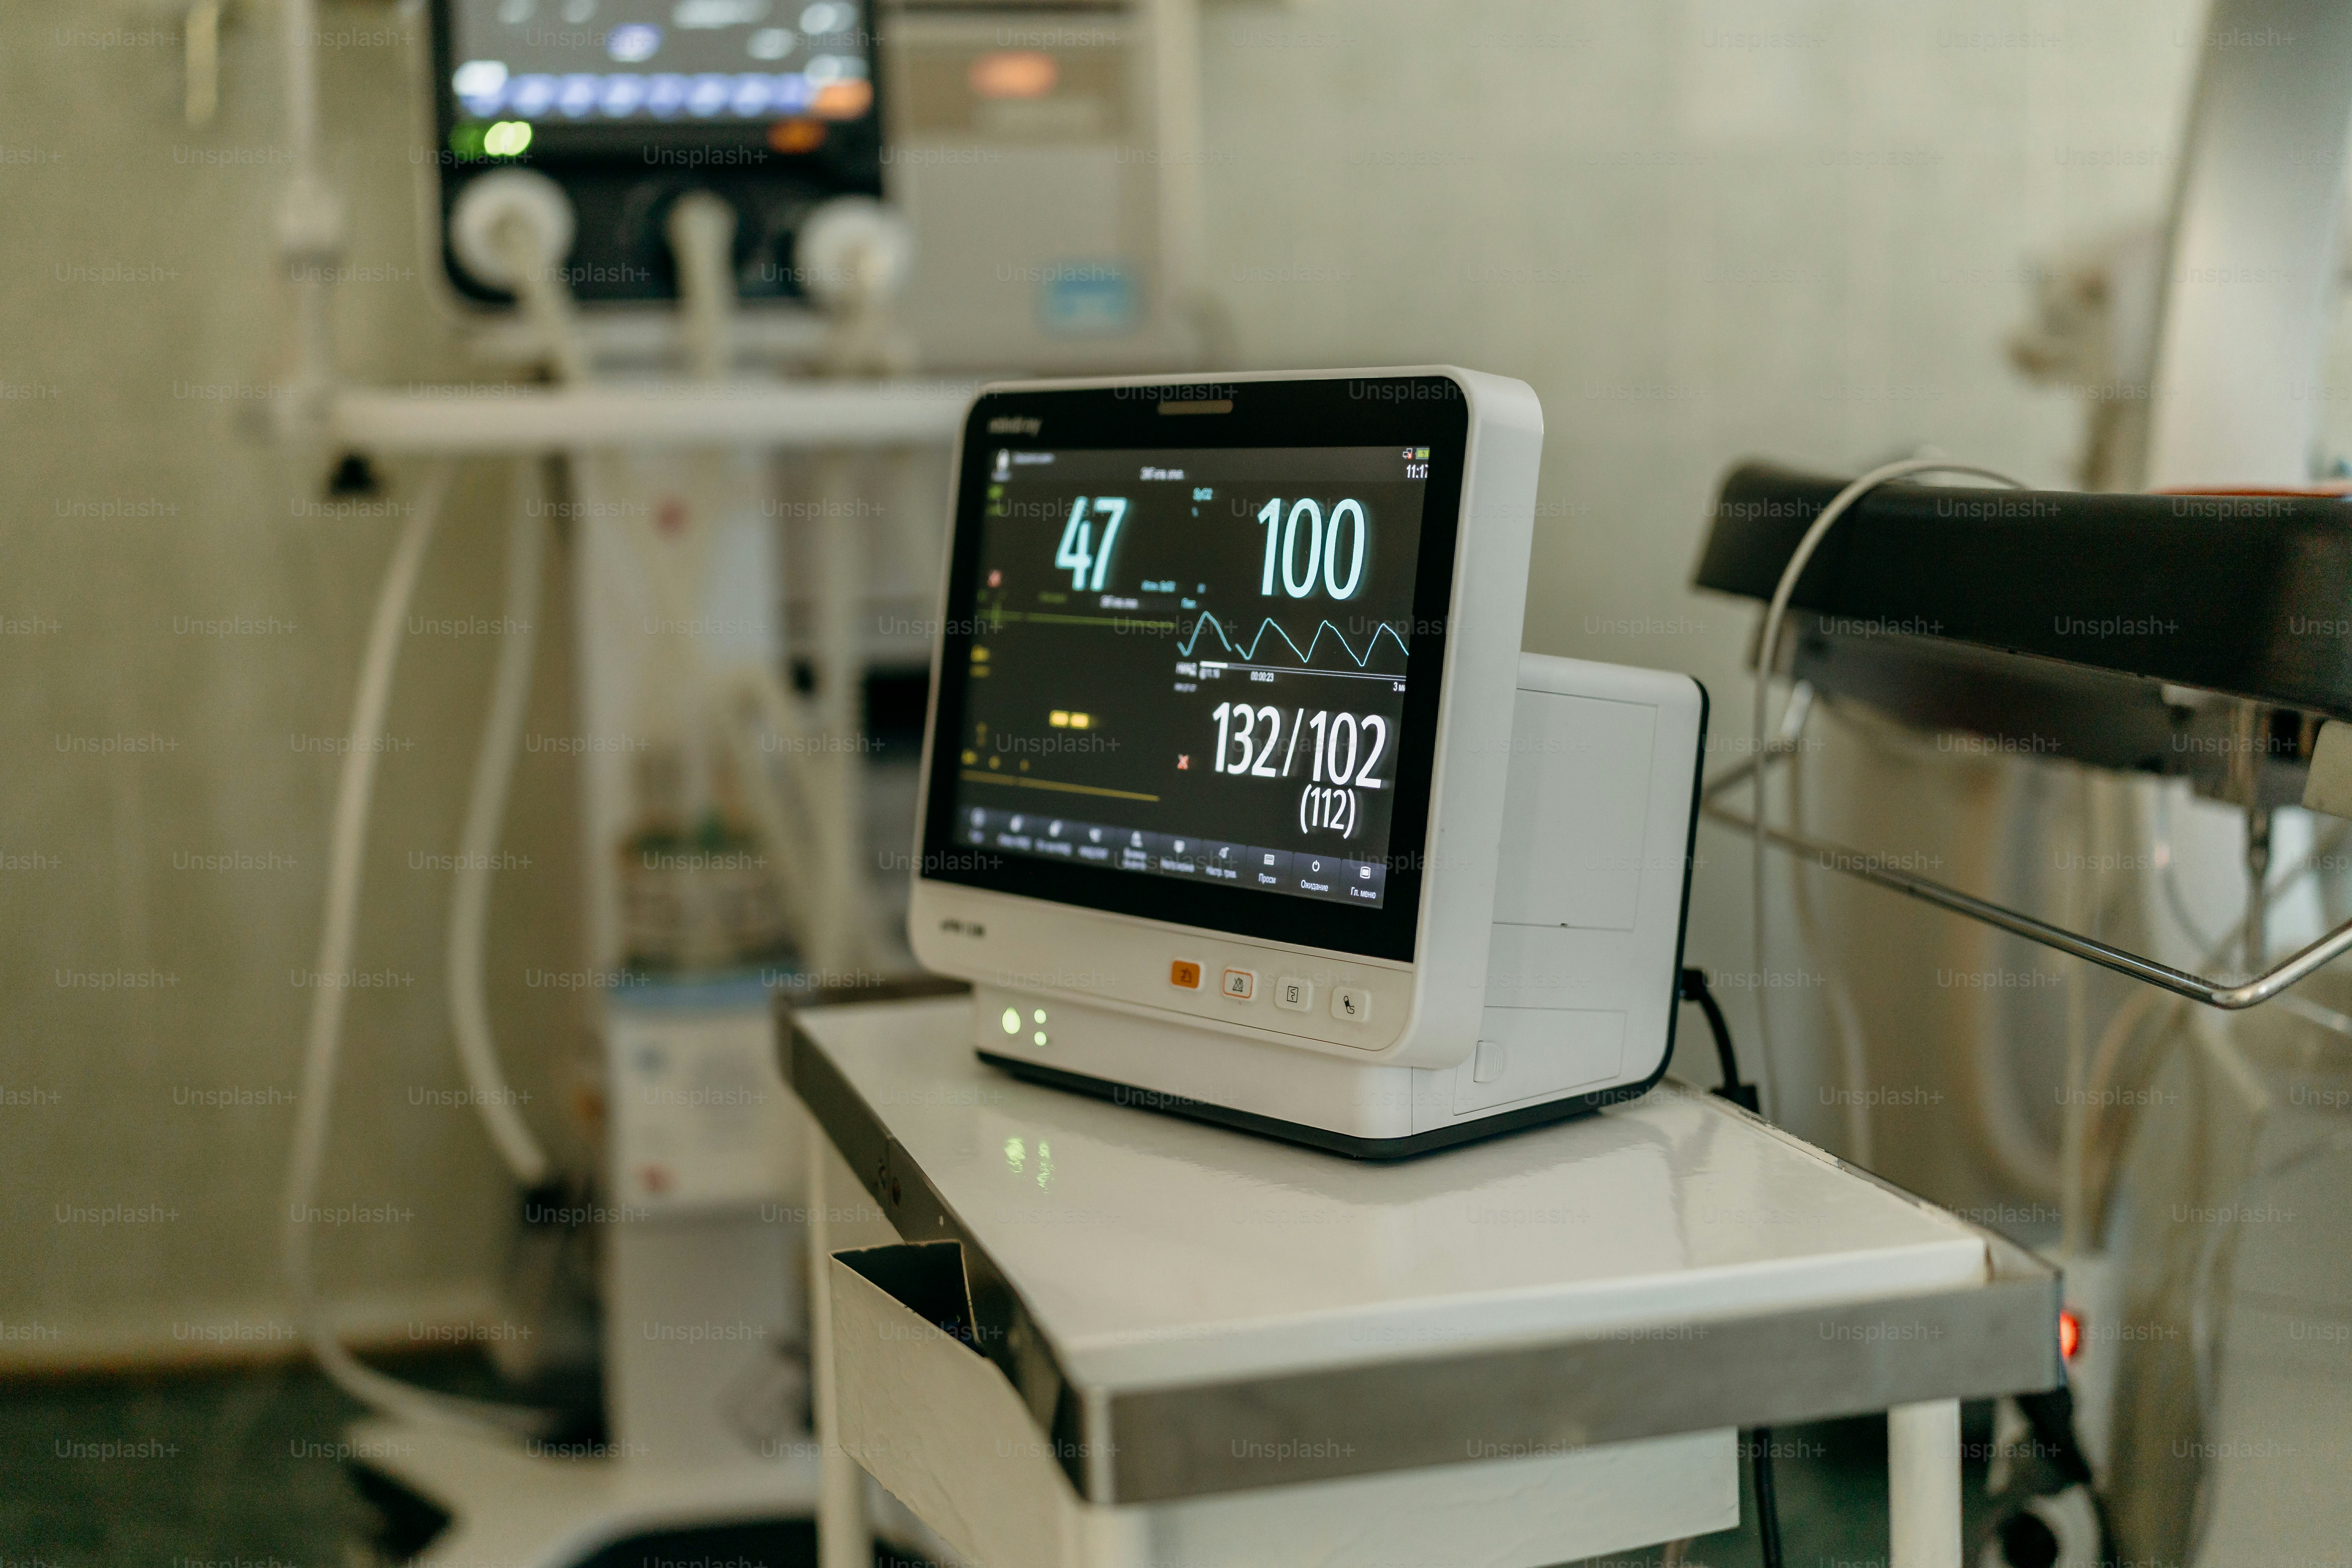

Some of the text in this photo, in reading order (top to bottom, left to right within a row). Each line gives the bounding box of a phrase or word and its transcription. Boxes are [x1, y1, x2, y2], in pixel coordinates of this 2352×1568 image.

[1054, 496, 1127, 591] 47
[1257, 497, 1365, 600] 100
[1393, 681, 1398, 691] 3
[1300, 784, 1355, 839] (112)
[1301, 879, 1328, 891] Ожидание
[1351, 887, 1376, 899] Гл. меню
